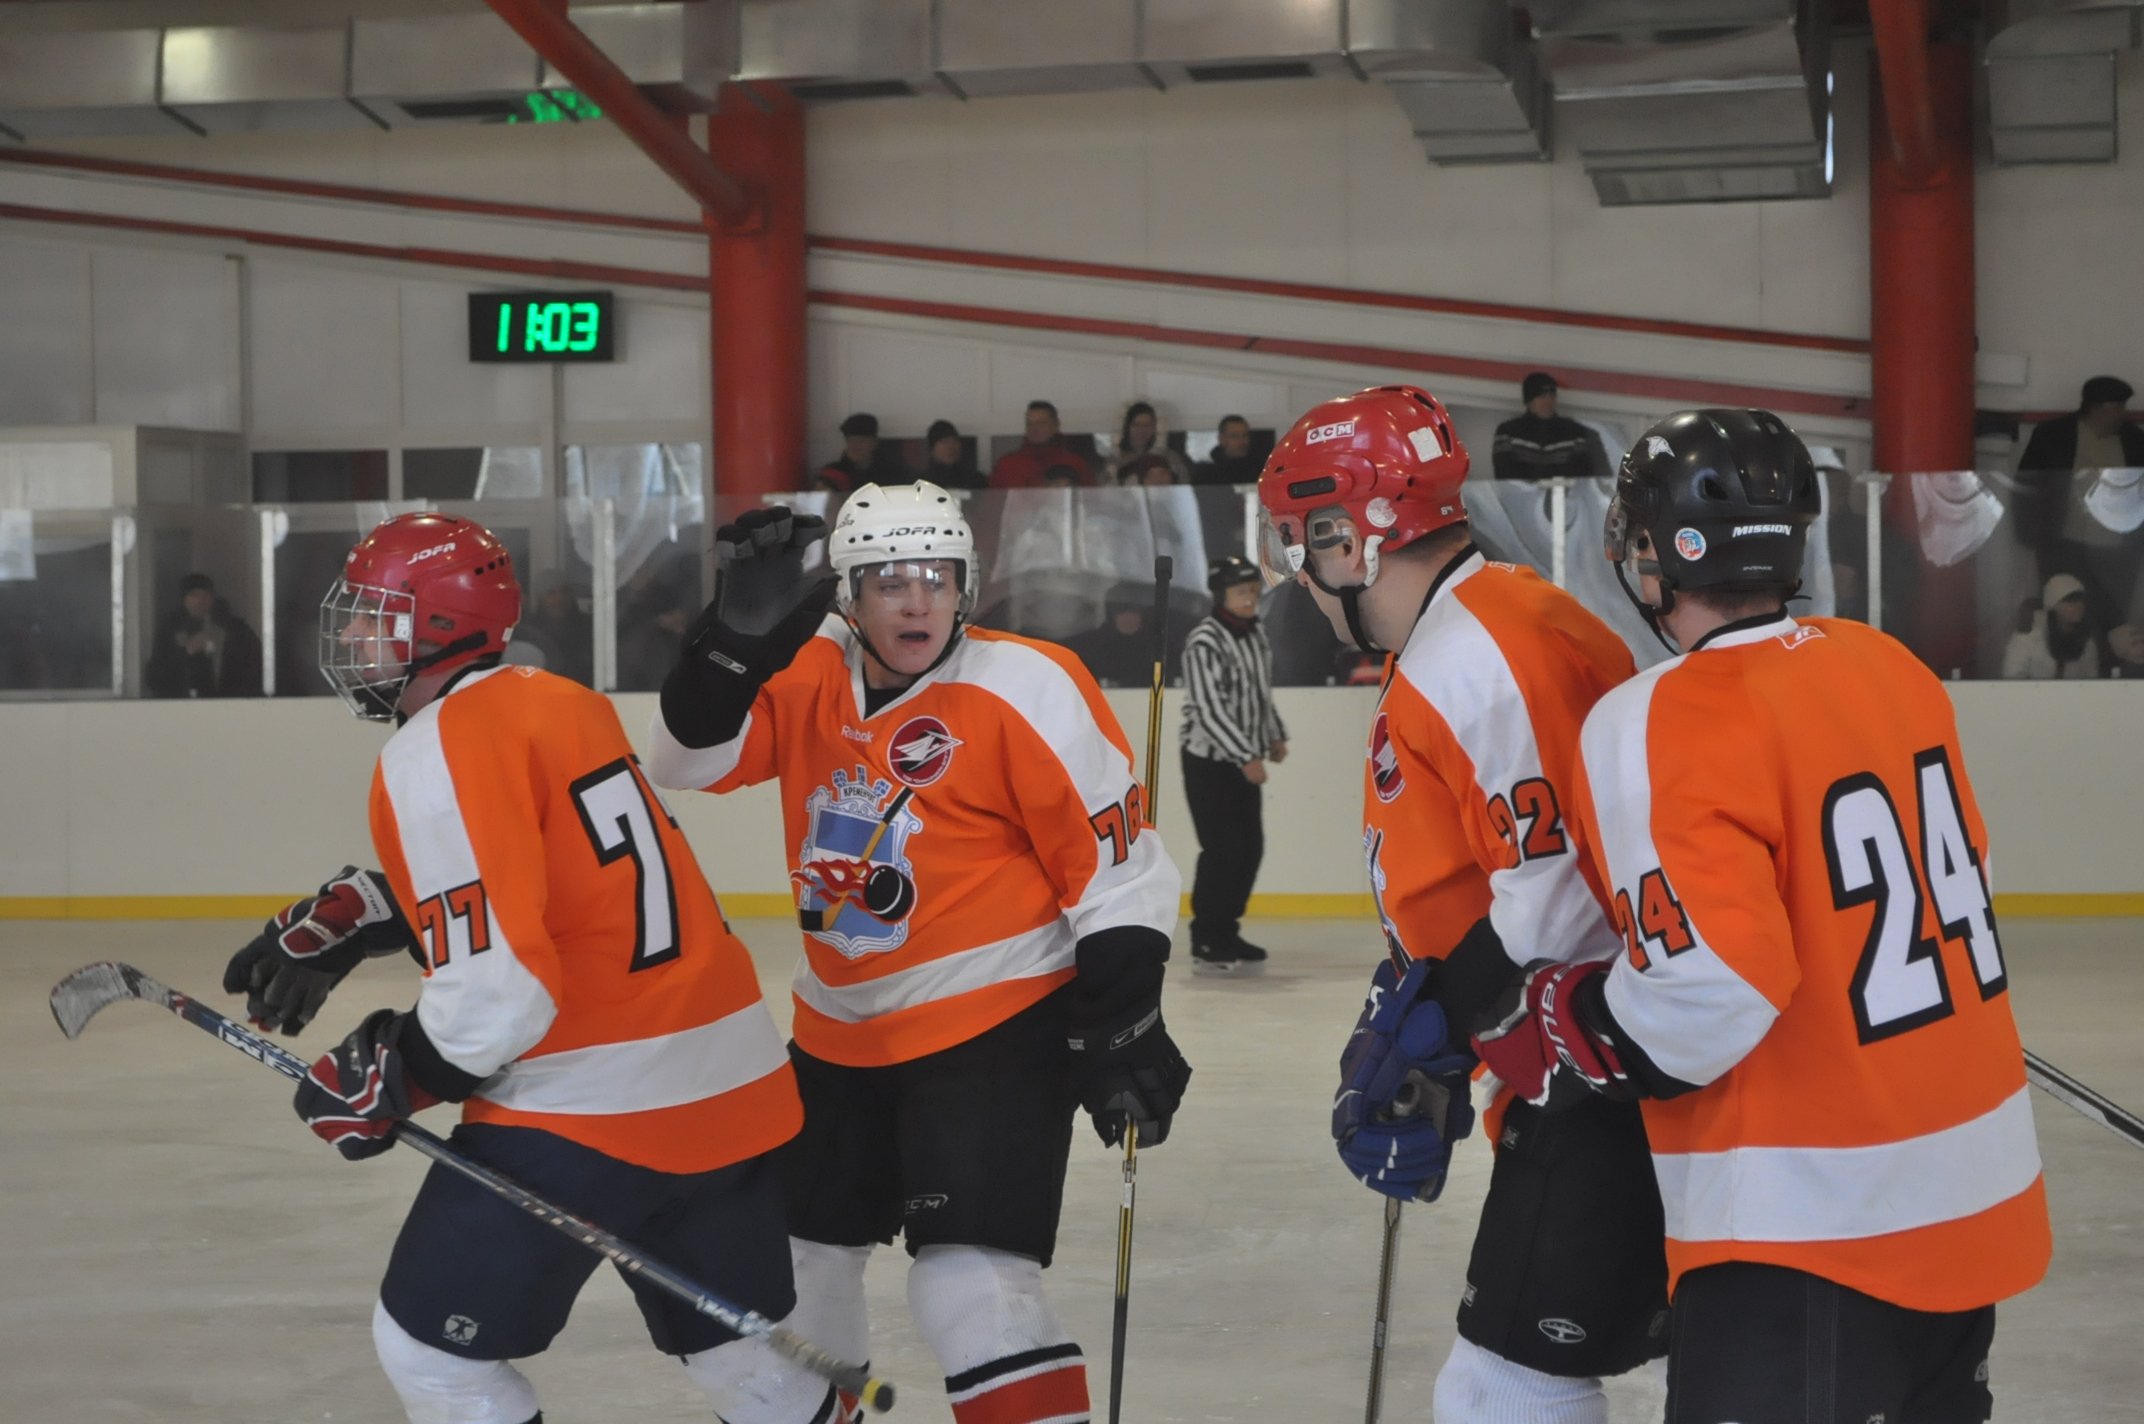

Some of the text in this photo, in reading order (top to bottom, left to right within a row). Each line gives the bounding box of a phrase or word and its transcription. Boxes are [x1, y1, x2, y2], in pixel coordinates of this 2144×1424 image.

[497, 302, 599, 353] 11:03
[407, 542, 456, 565] JOFA
[882, 526, 936, 538] JOFA
[1732, 523, 1793, 538] MISSION
[568, 753, 700, 973] 7
[1487, 777, 1568, 869] 22
[416, 879, 492, 968] 77
[1615, 867, 1697, 973] 24
[1821, 744, 2008, 1046] 24
